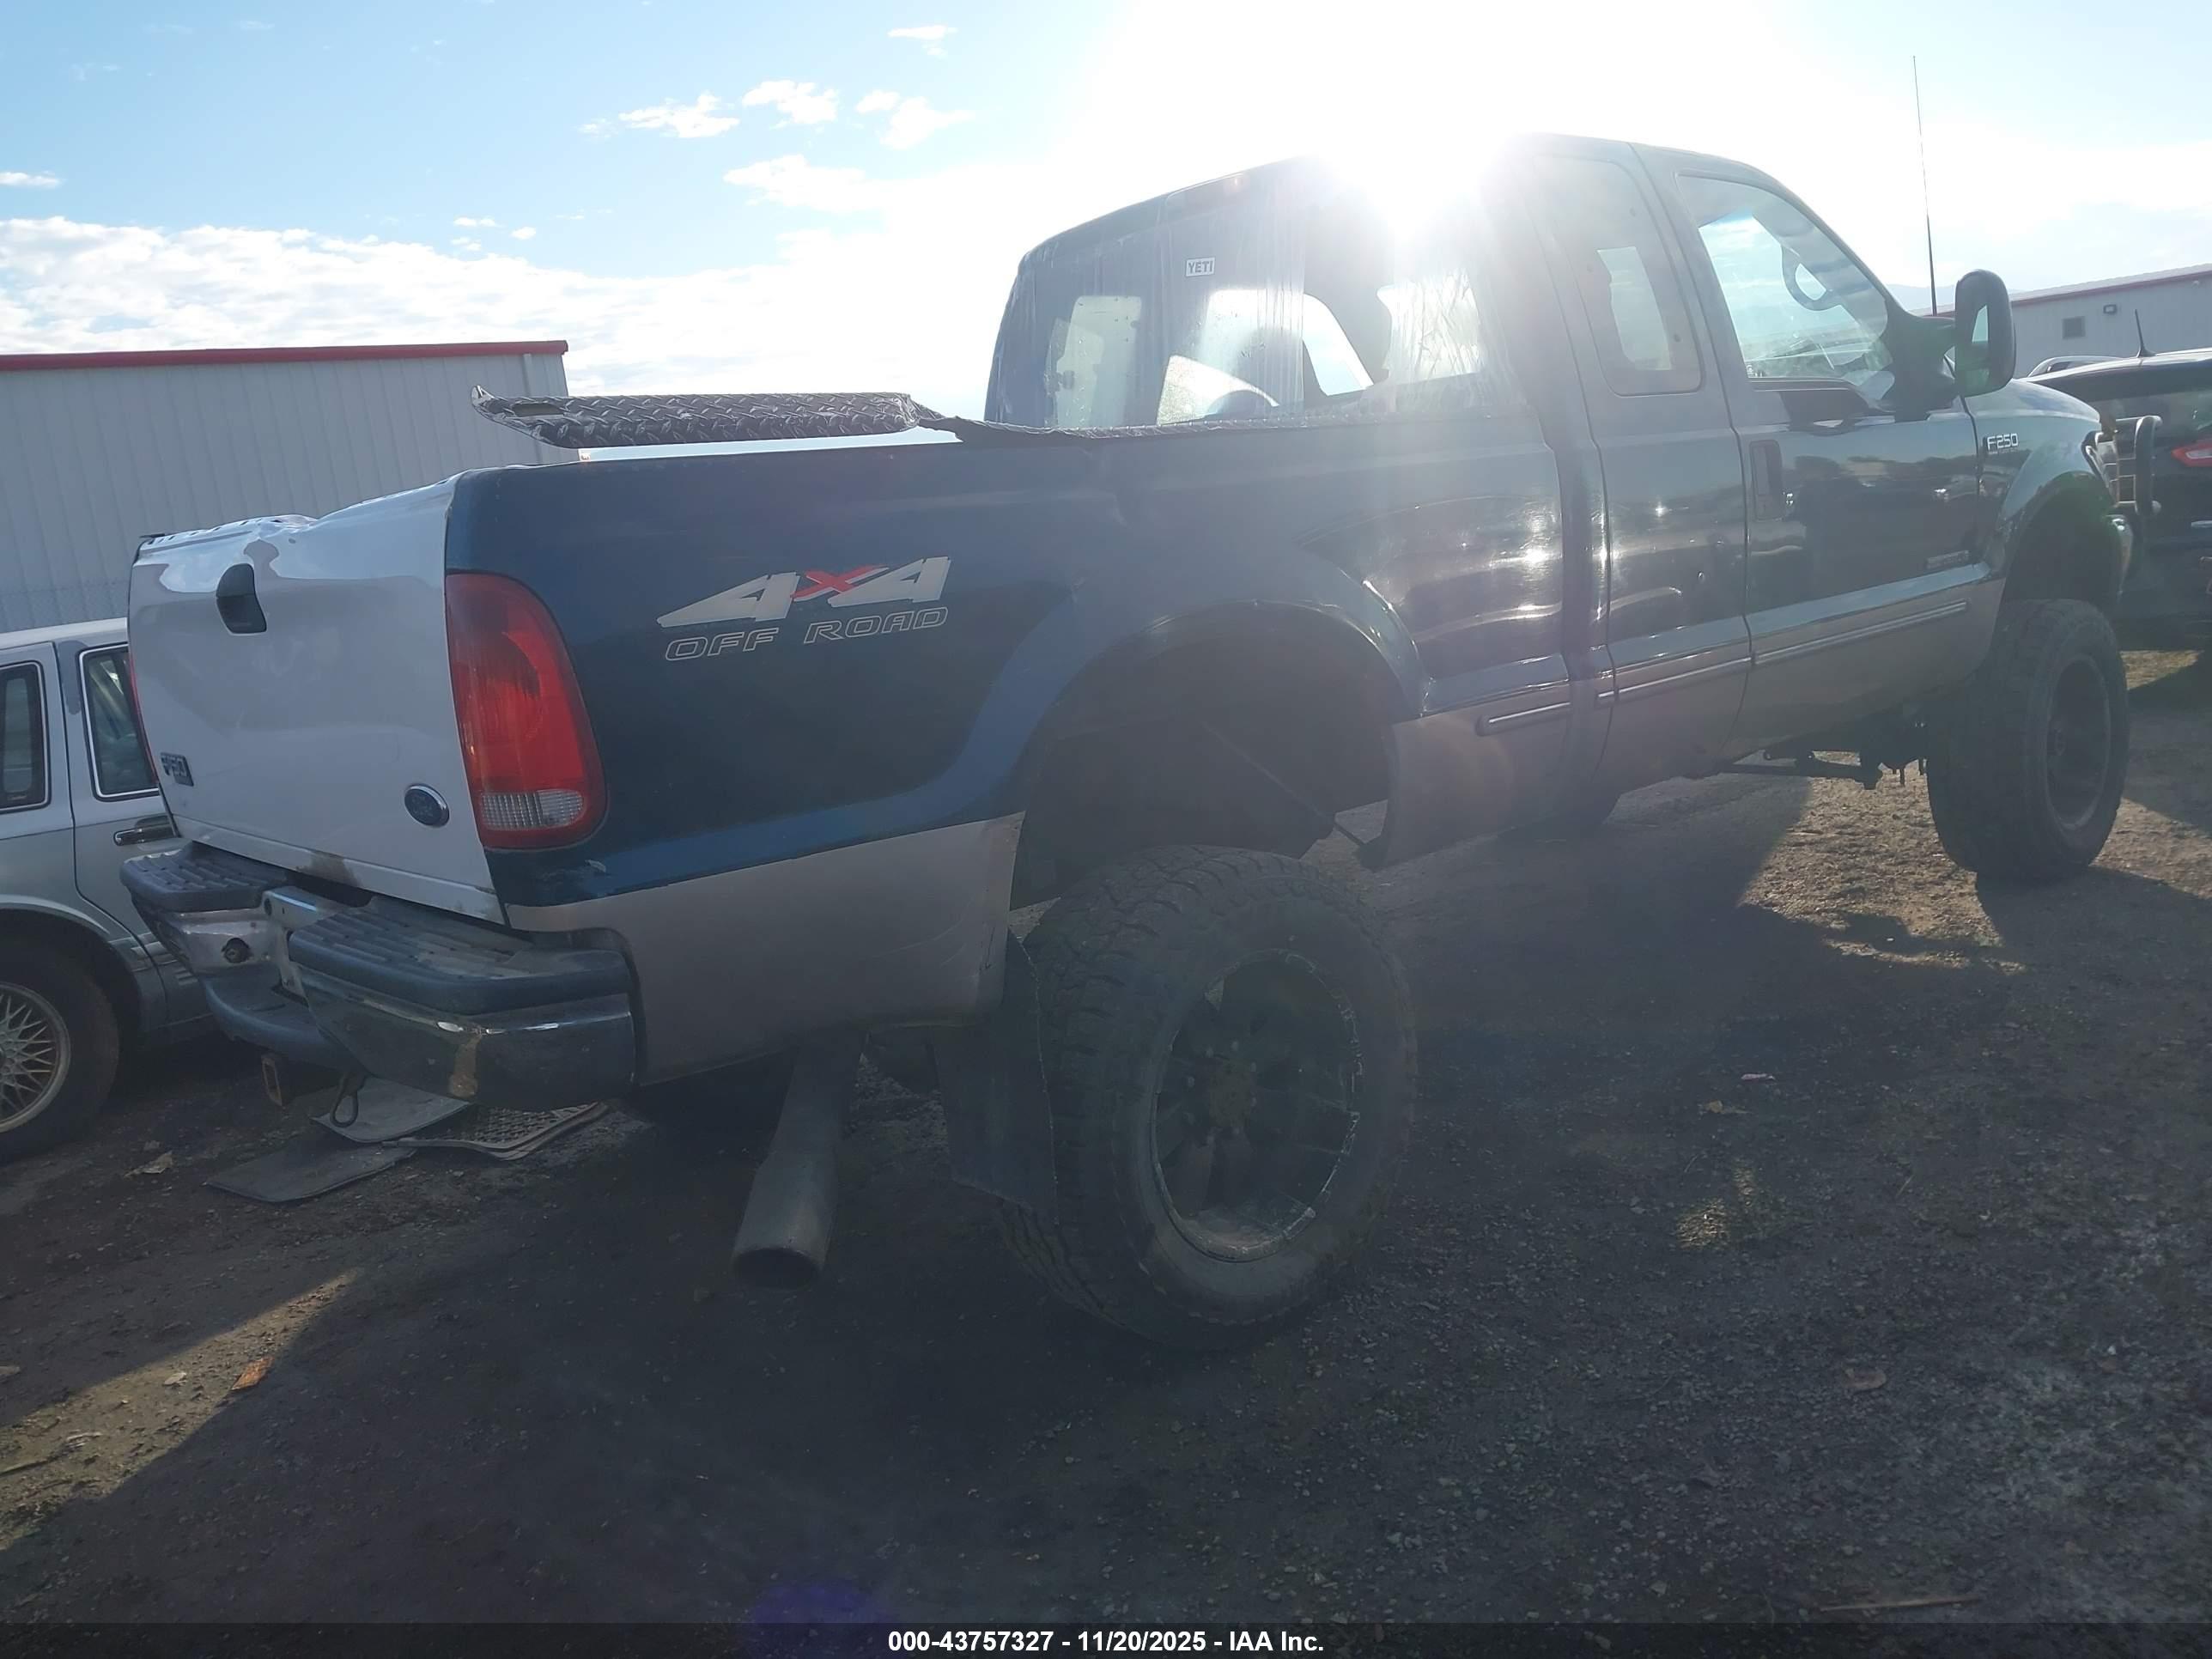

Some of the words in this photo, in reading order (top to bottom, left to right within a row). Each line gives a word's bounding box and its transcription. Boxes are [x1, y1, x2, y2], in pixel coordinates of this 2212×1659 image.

[1188, 260, 1213, 274] YETI
[665, 628, 779, 660] OFF
[804, 607, 948, 644] ROAD
